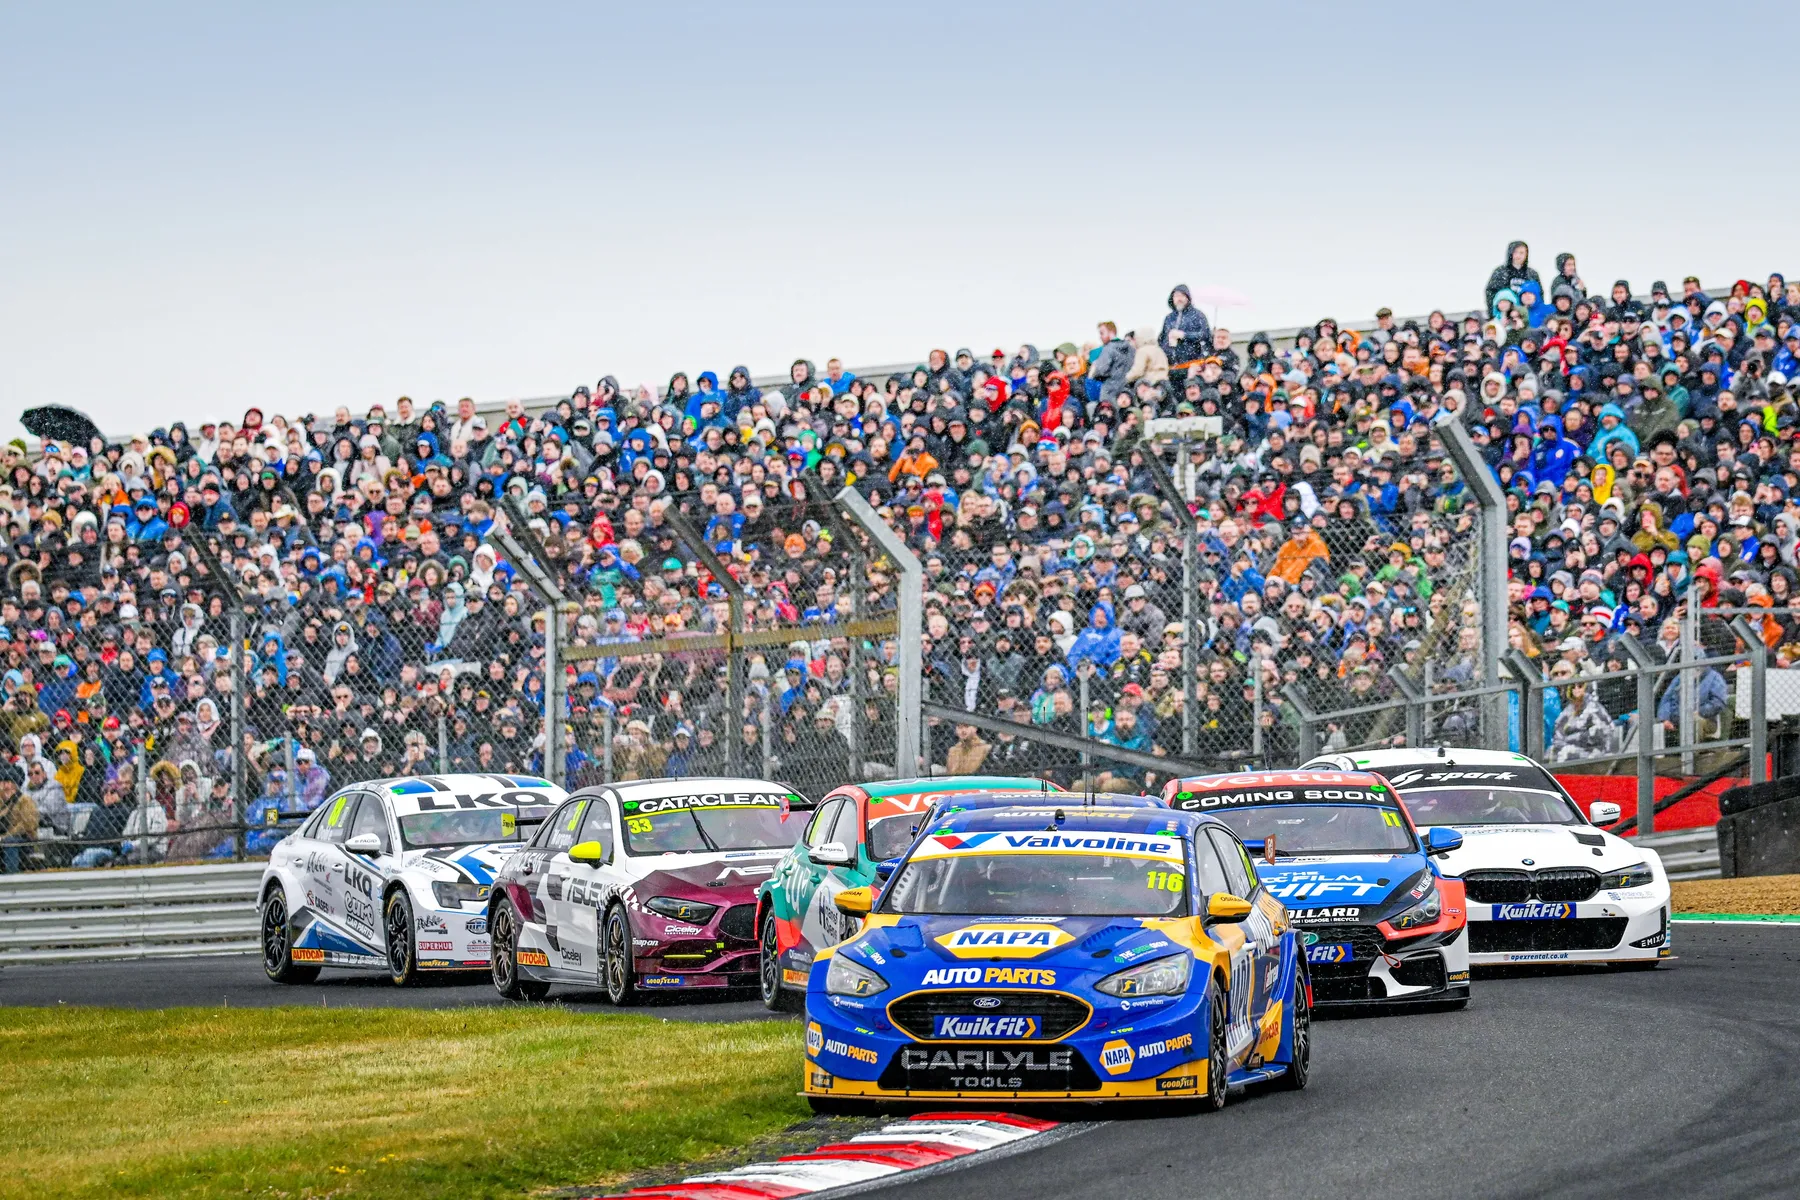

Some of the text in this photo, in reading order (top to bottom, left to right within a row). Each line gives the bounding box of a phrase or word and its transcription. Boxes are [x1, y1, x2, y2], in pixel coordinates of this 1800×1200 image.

[1425, 772, 1518, 782] spark
[417, 792, 557, 811] LKQ
[638, 794, 784, 813] CATACLEAN
[1181, 790, 1385, 810] COMING SOON
[627, 818, 653, 834] 33
[1381, 811, 1401, 827] 11
[1005, 836, 1171, 854] Valvoline
[344, 862, 372, 901] LKQ
[1147, 870, 1185, 893] 116
[1265, 883, 1386, 898] HIFT
[1287, 908, 1360, 919] OLLARD
[665, 926, 703, 936] Ciceley
[956, 931, 1051, 946] NAPA
[419, 942, 453, 950] SUPERHUB
[632, 938, 659, 947] Snap-on
[1641, 934, 1665, 948] EMIXA
[518, 953, 547, 966] AUTOCAR
[1119, 948, 1136, 961] THE
[1511, 953, 1568, 962] apexrental.co.uk
[646, 976, 680, 985] GOODYEAR
[921, 967, 1056, 986] AUTO PARTS
[978, 999, 995, 1007] Ford
[1132, 999, 1164, 1008] everywhen
[825, 1039, 878, 1064] AUTO PARTS
[1138, 1033, 1192, 1059] AUTO PARTS
[901, 1050, 1073, 1071] CARLYLE
[1105, 1048, 1131, 1066] NAPA
[950, 1077, 1023, 1088] TOOLS
